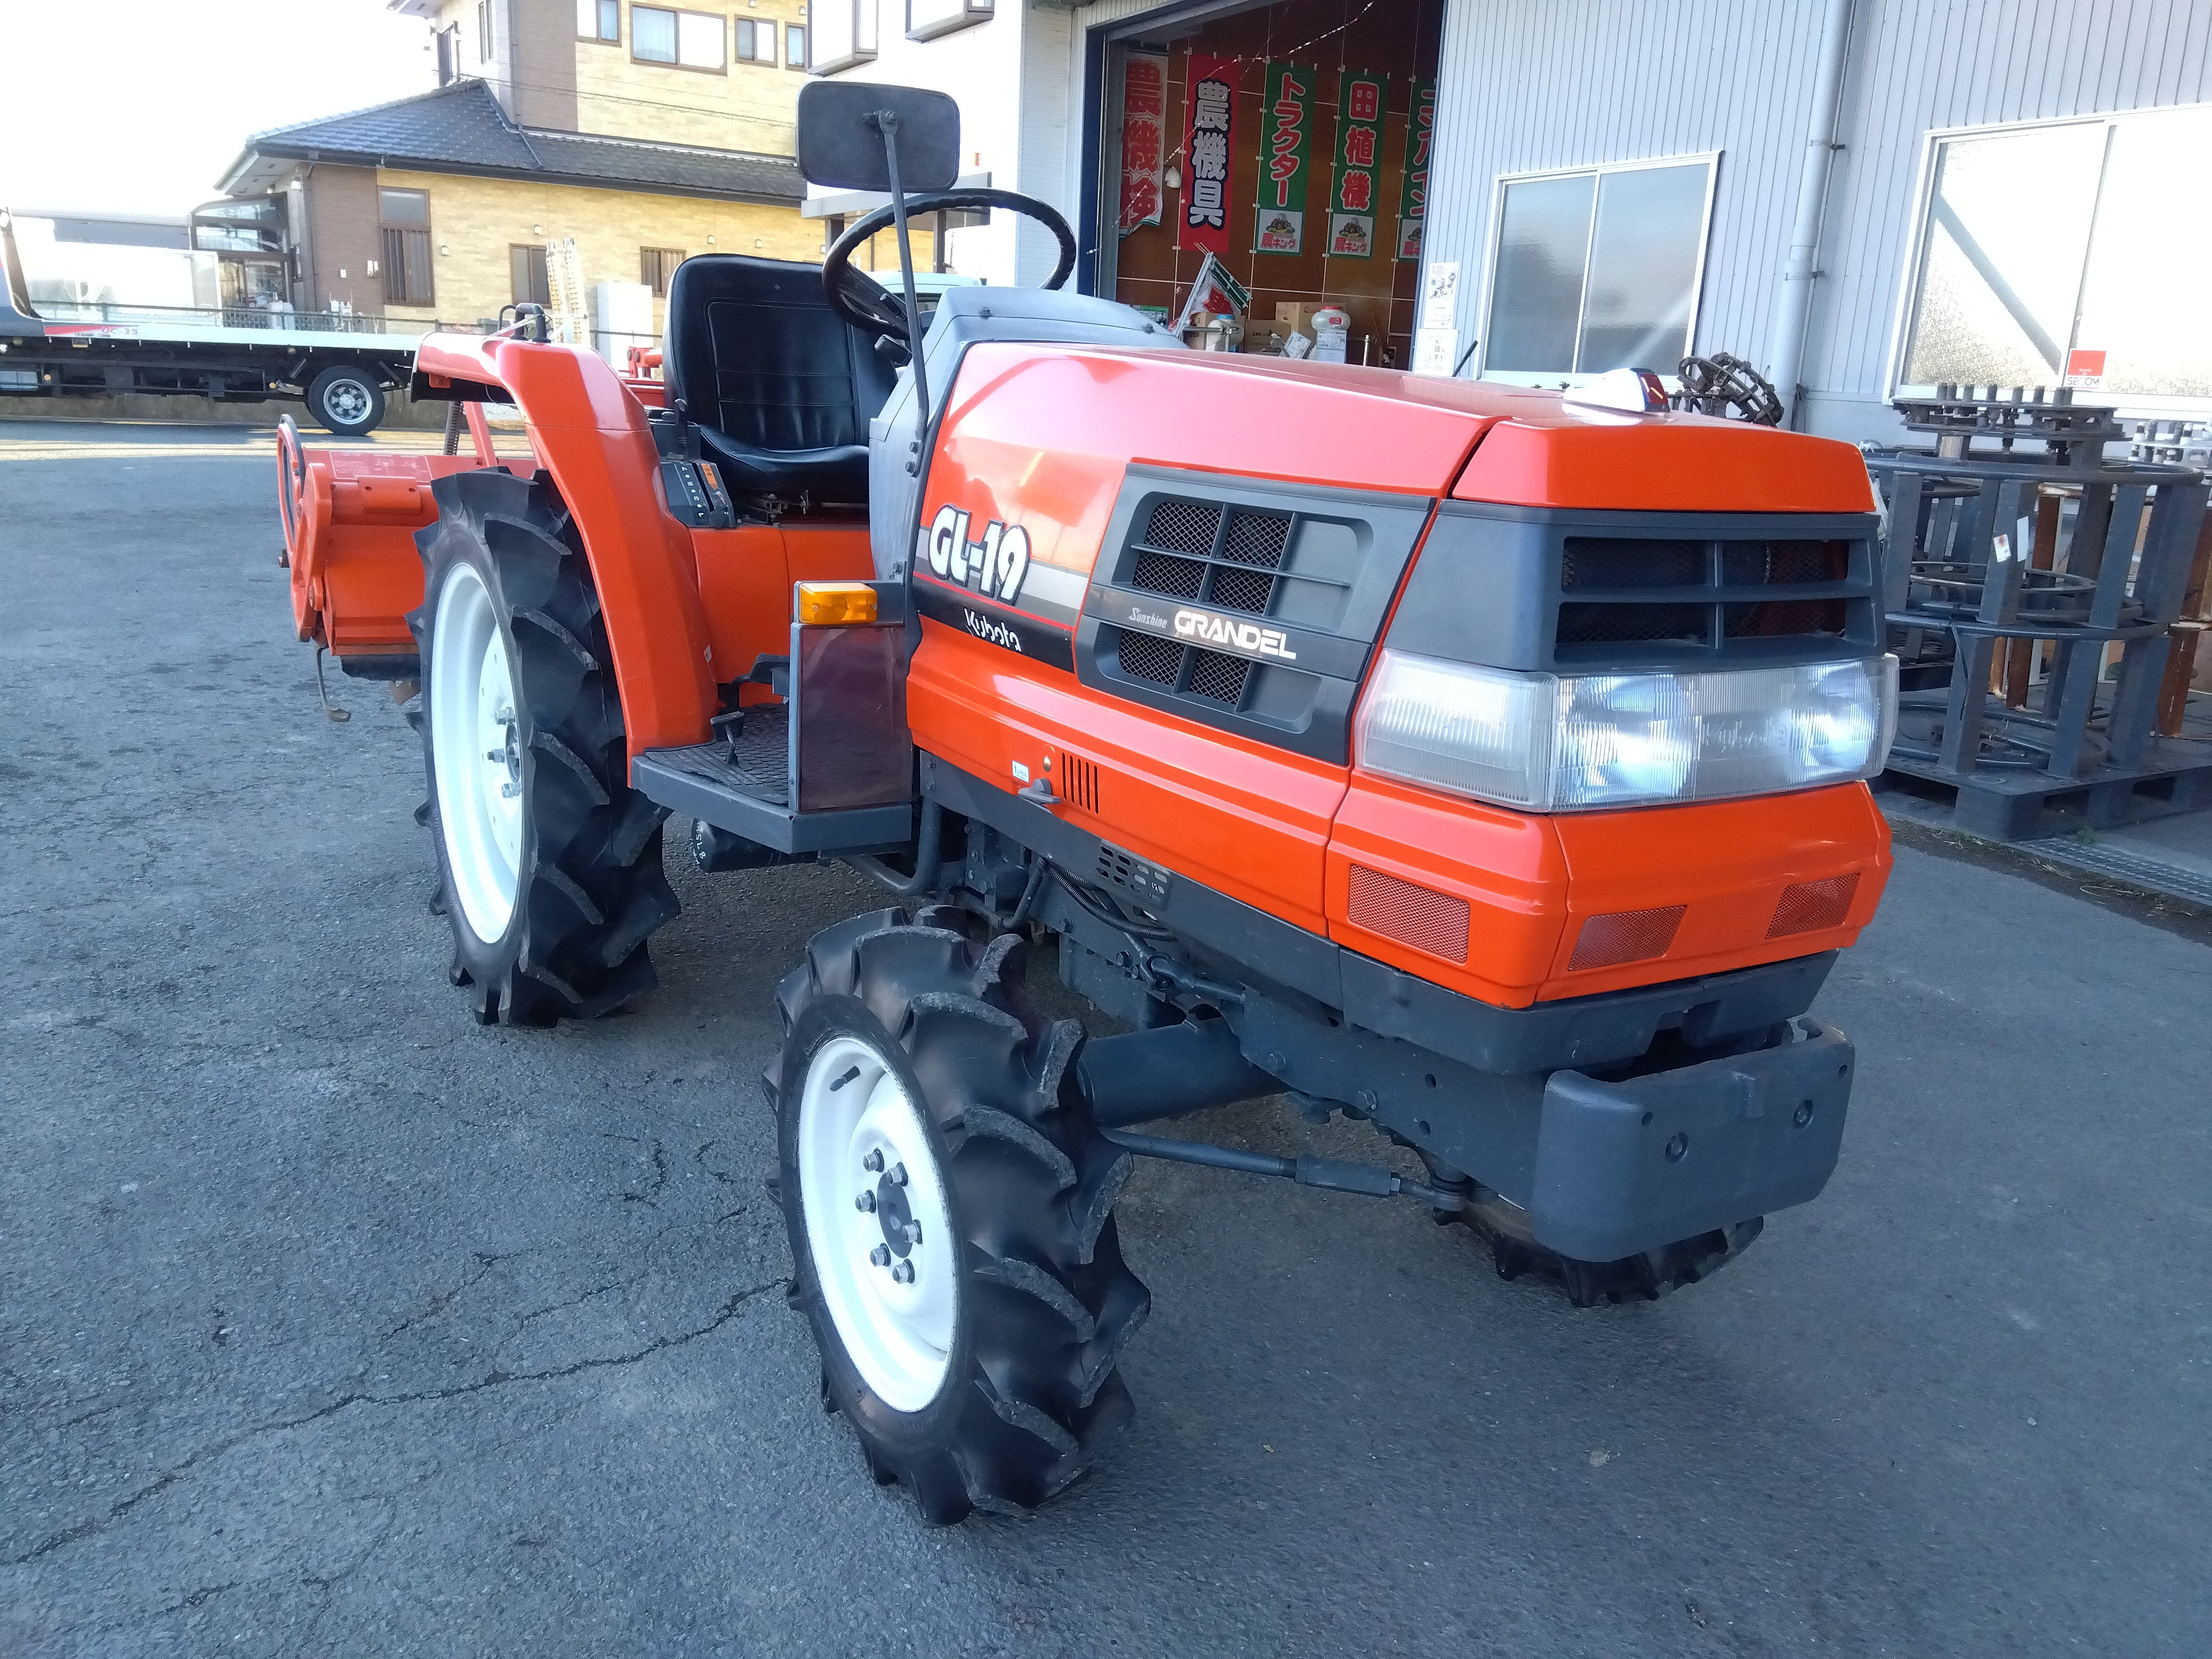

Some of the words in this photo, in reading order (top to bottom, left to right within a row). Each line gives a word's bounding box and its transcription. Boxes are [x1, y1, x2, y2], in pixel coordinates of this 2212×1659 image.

[1188, 79, 1230, 229] 農機具
[1270, 72, 1305, 207] トラクター
[1340, 81, 1379, 211] 田植機
[2067, 376, 2099, 386] SECOM
[928, 504, 1030, 606] GL-19
[963, 607, 1021, 652] Kubota
[1128, 607, 1168, 629] Sunshine
[1174, 610, 1296, 660] GRANDEL
